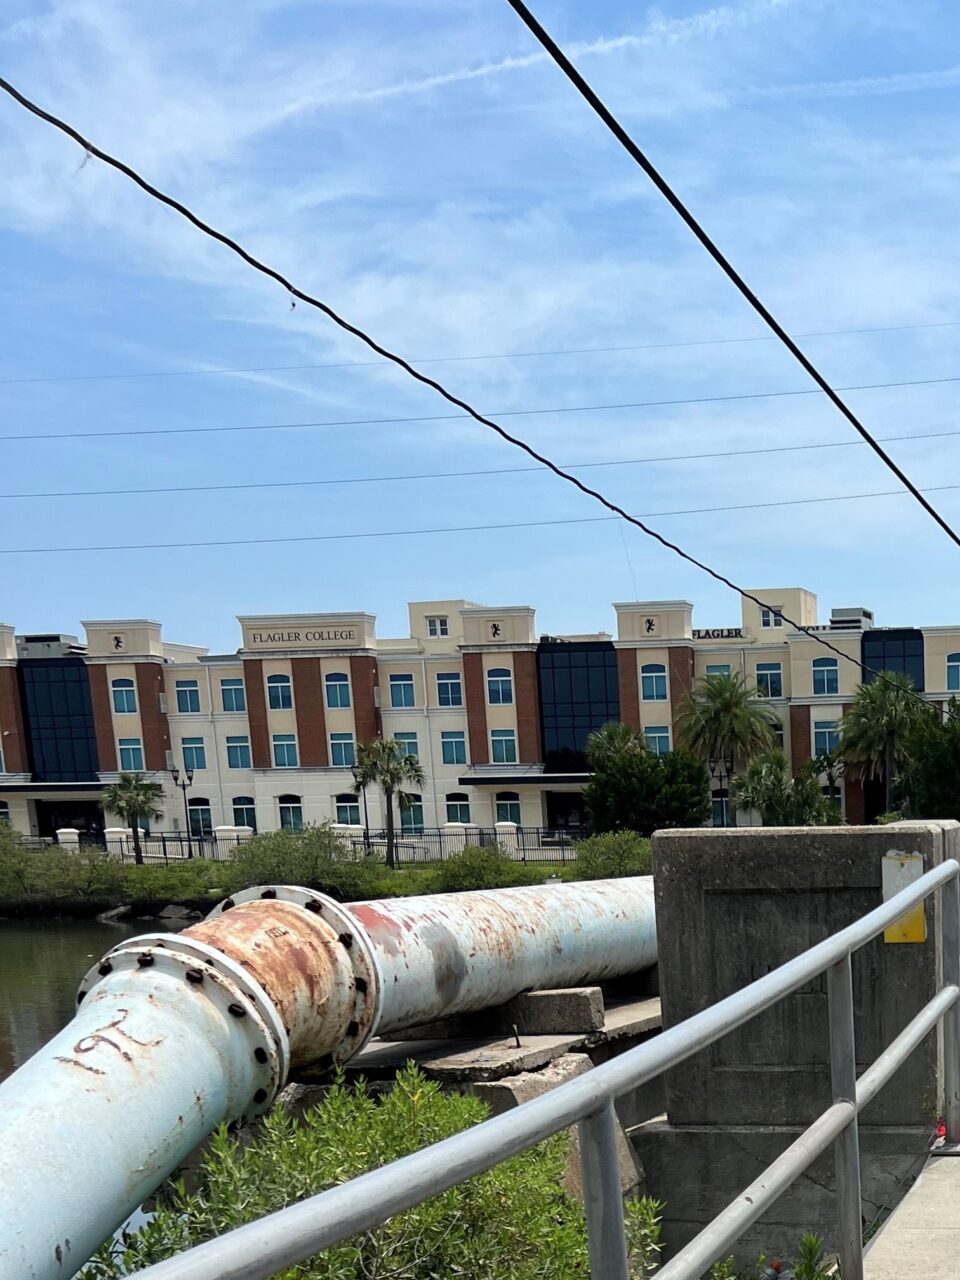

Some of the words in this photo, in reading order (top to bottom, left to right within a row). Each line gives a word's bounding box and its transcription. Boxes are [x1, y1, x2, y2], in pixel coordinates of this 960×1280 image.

[253, 632, 302, 643] FLAGLER
[305, 630, 355, 641] COLLEGE
[692, 628, 743, 639] FLAGLER
